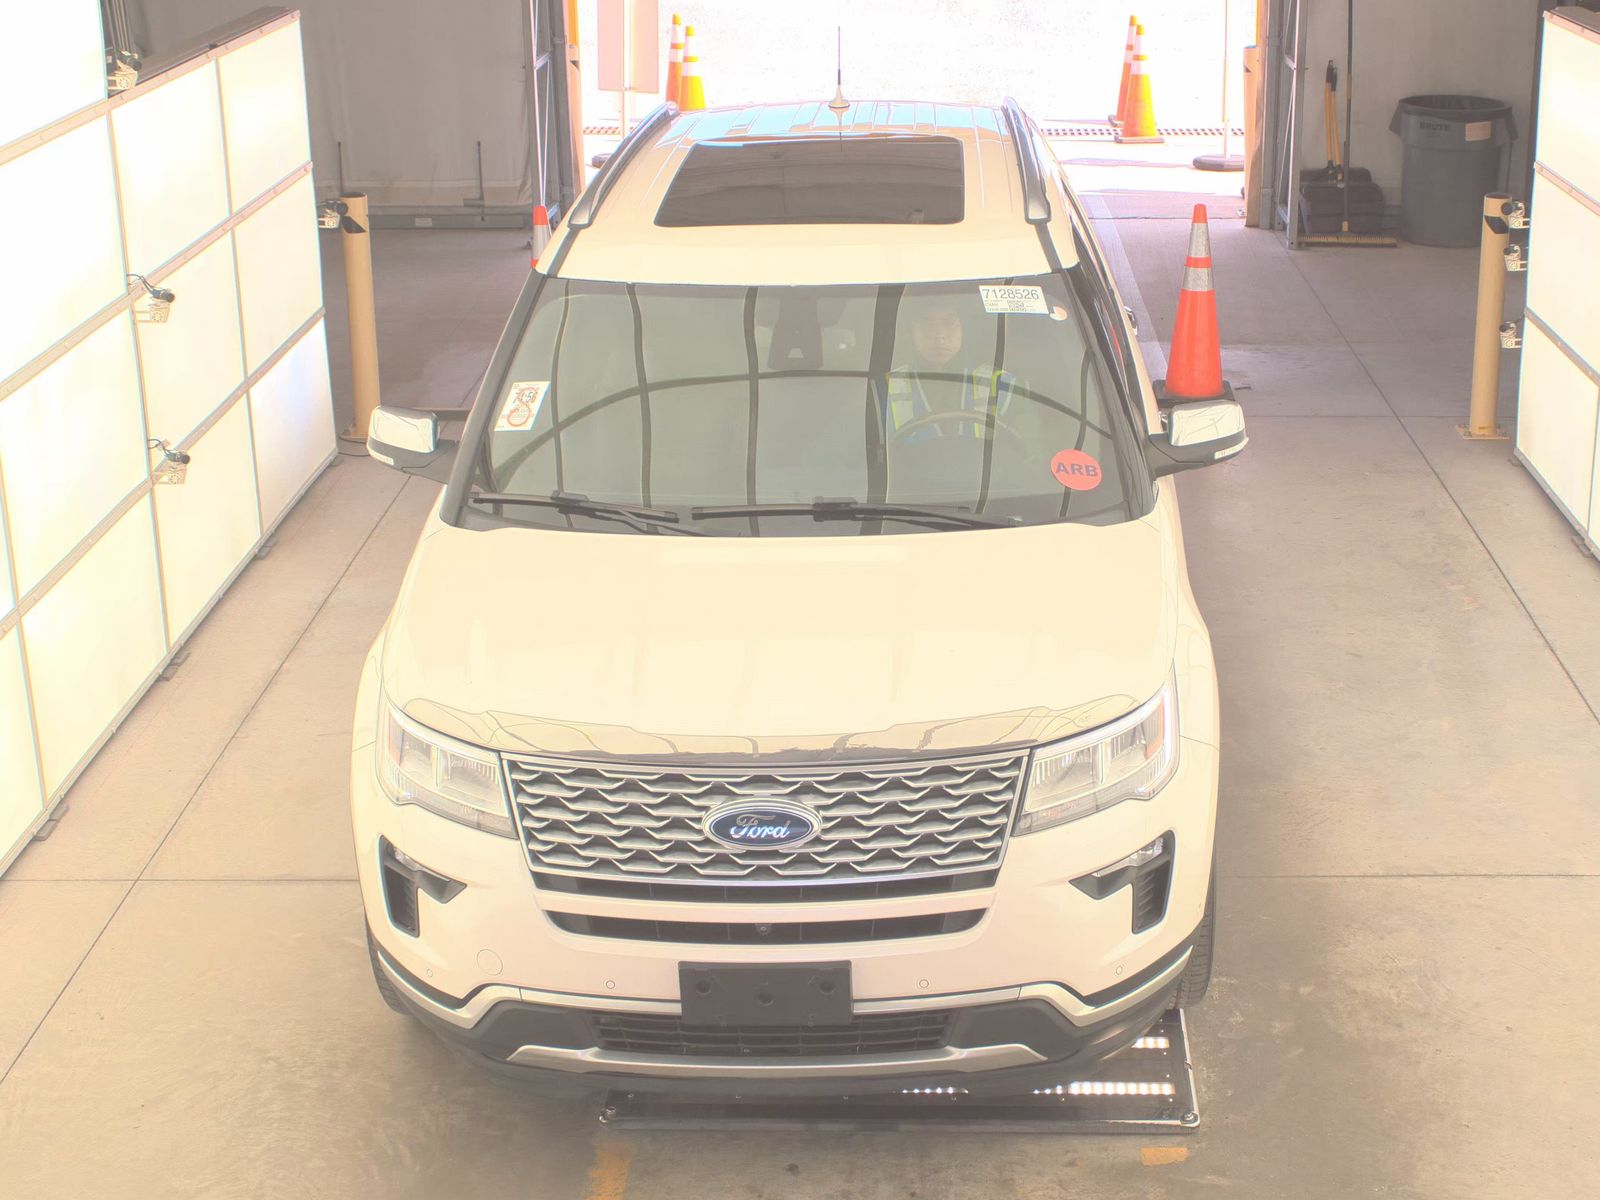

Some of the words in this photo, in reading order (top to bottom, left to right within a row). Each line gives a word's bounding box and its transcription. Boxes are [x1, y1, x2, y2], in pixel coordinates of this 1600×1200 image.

[982, 288, 1039, 300] 7128526
[1056, 462, 1098, 477] ARB
[730, 813, 791, 839] Ford
